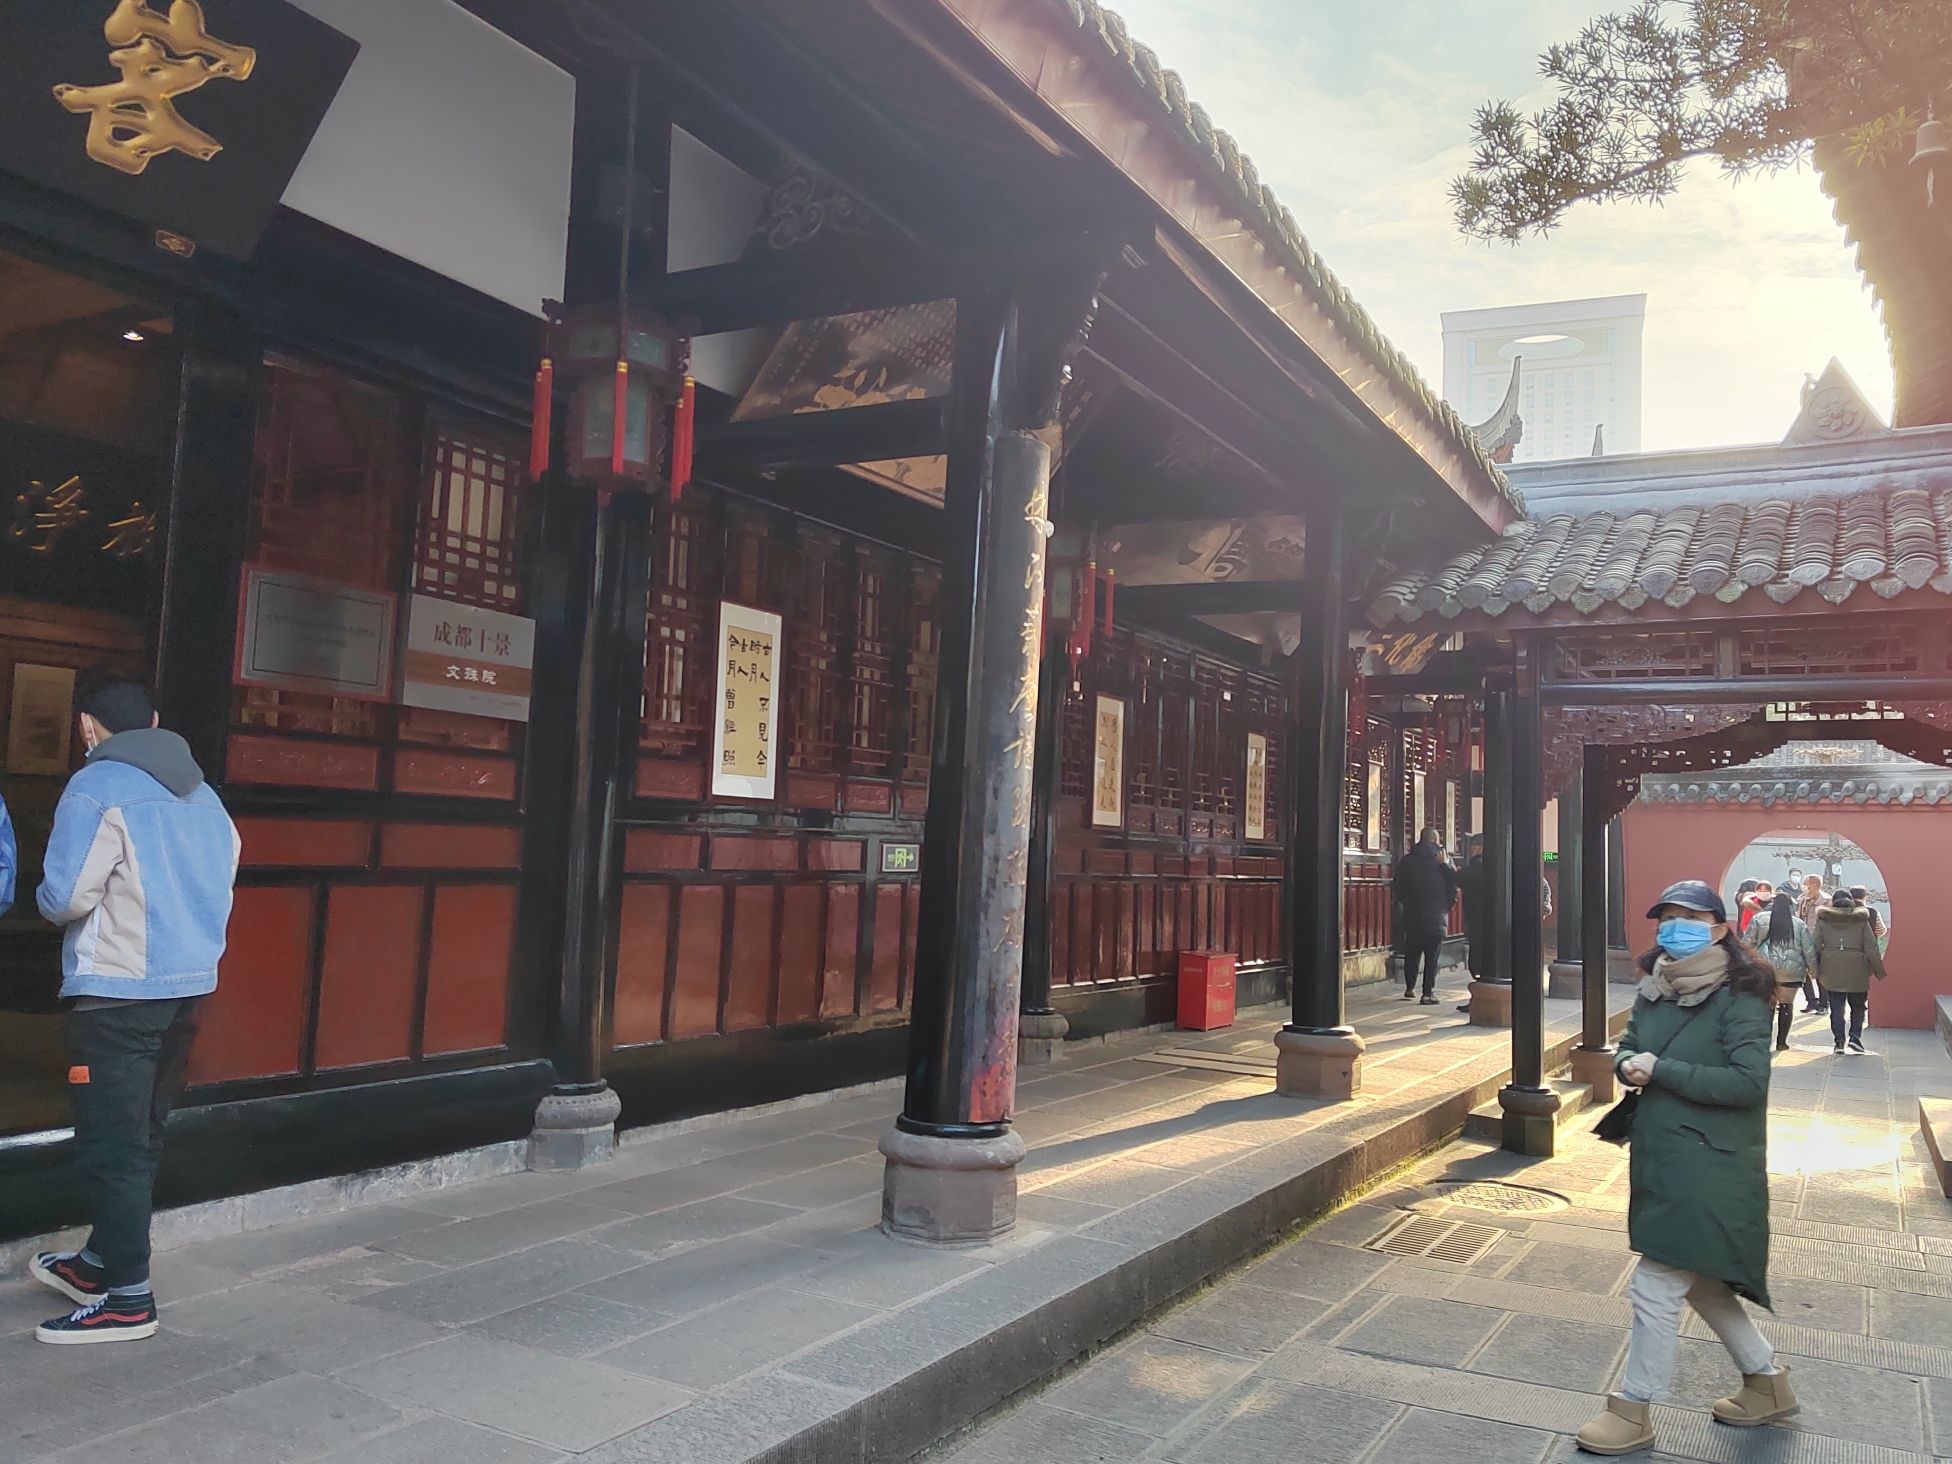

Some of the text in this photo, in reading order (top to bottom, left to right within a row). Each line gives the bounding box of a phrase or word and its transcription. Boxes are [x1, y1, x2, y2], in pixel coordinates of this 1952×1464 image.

[433, 620, 511, 656] 成都十景
[446, 664, 498, 686] 文殊院
